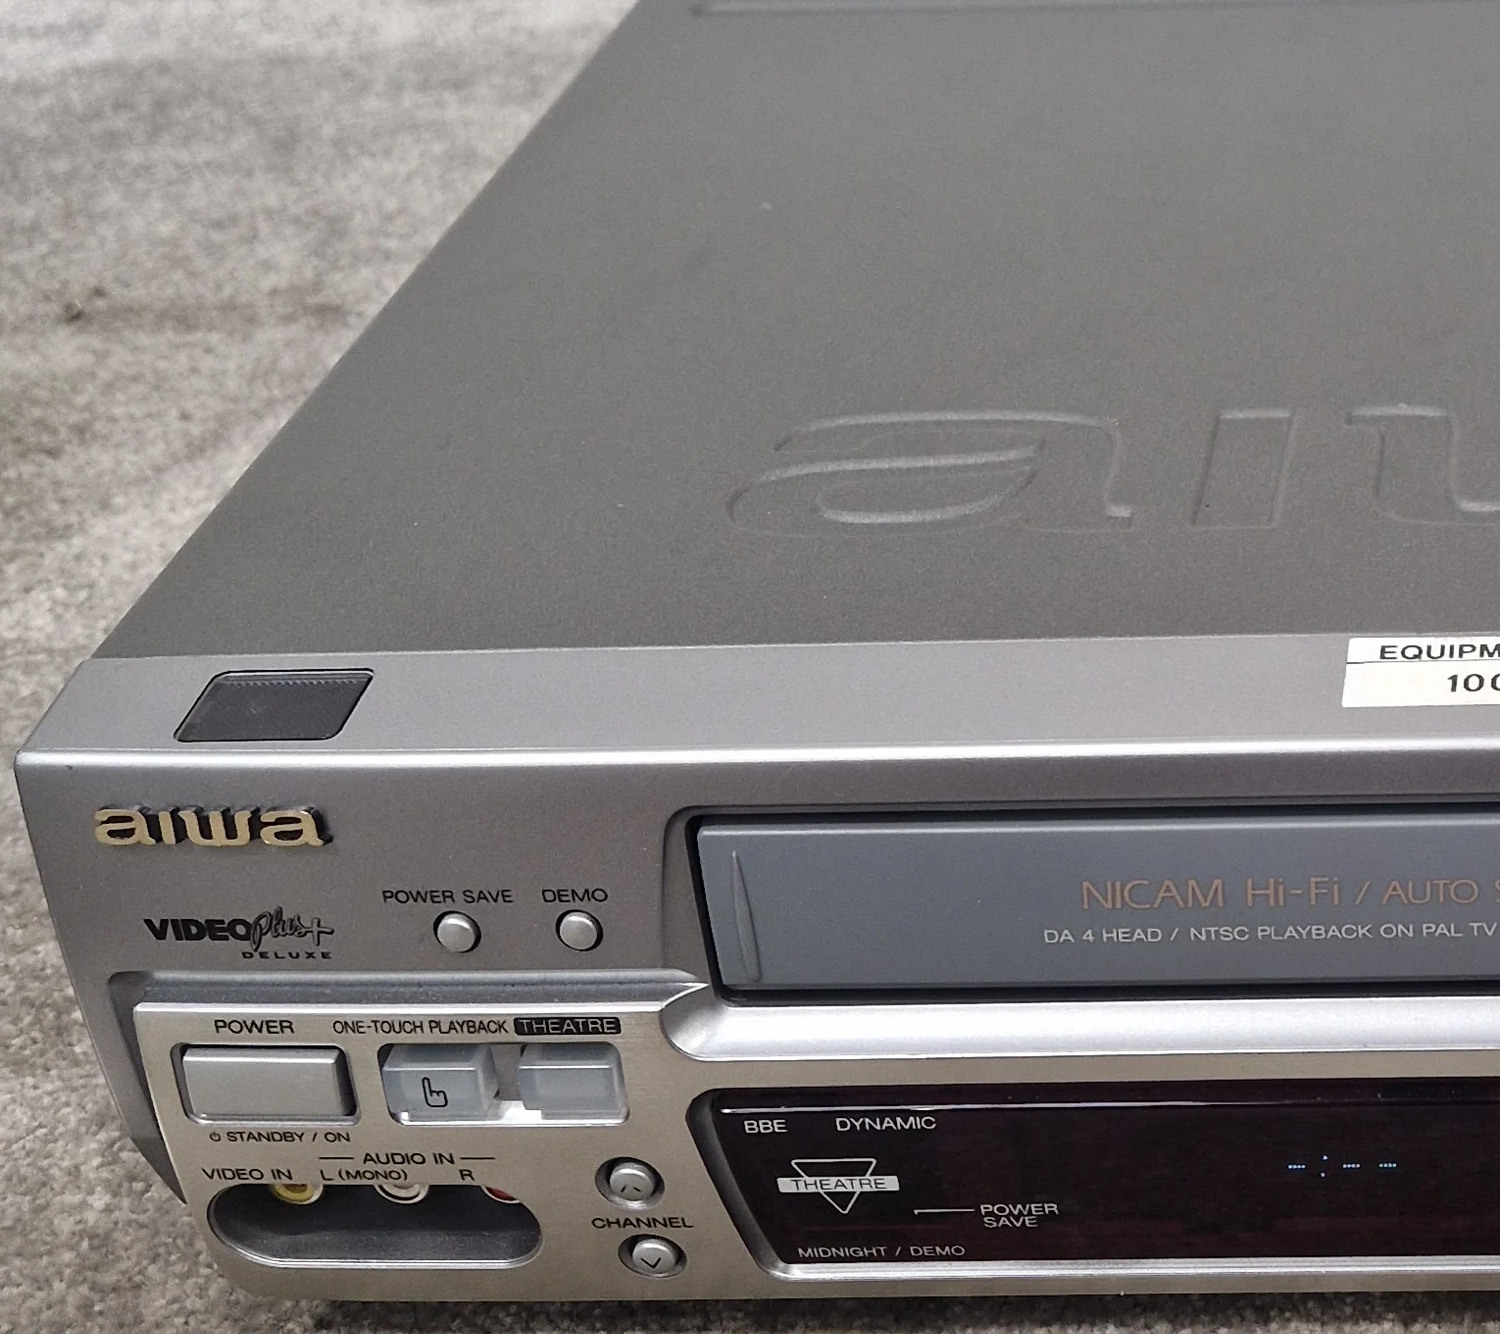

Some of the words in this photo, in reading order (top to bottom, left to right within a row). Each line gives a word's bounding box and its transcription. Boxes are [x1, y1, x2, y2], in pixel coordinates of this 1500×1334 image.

[94, 805, 334, 847] aiwa
[382, 889, 456, 904] POWER
[463, 889, 515, 904] SAVE
[541, 887, 609, 904] DEMO
[1081, 878, 1224, 910] NICAM
[1246, 877, 1340, 907] Hi-Fi
[1382, 878, 1480, 905] AUTO
[143, 917, 254, 942] VIDEO
[1043, 929, 1075, 944] DA
[1082, 929, 1095, 943] 4
[1102, 928, 1163, 943] HEAD
[1189, 926, 1250, 942] NTSC
[1257, 923, 1374, 941] PLAYBACK
[1379, 923, 1415, 939] ON
[1422, 922, 1464, 938] PAL
[1468, 921, 1499, 937] TV
[241, 951, 332, 960] DELUXE
[214, 1019, 296, 1035] POWER
[332, 1019, 424, 1035] ONE-TOUCH
[428, 1019, 509, 1035] PLAYBACK
[519, 1018, 618, 1034] THEATRE
[744, 1119, 788, 1134] BBE
[835, 1115, 937, 1132] DYNAMIC
[226, 1131, 305, 1143] STANDBY
[324, 1130, 351, 1143] ON
[362, 1151, 427, 1166] AUDIO
[432, 1151, 455, 1165] IN
[201, 1167, 265, 1181] VIDEO
[271, 1167, 294, 1181] IN
[319, 1168, 334, 1182] L
[337, 1168, 408, 1182] (MONO)
[459, 1168, 476, 1182] R
[790, 1177, 887, 1191] THEATRE
[980, 1203, 1059, 1216] POWER
[591, 1216, 694, 1230] CHANNEL
[983, 1216, 1039, 1229] SAVE
[798, 1247, 887, 1259] MIDNIGHT
[910, 1245, 966, 1257] DEMO
